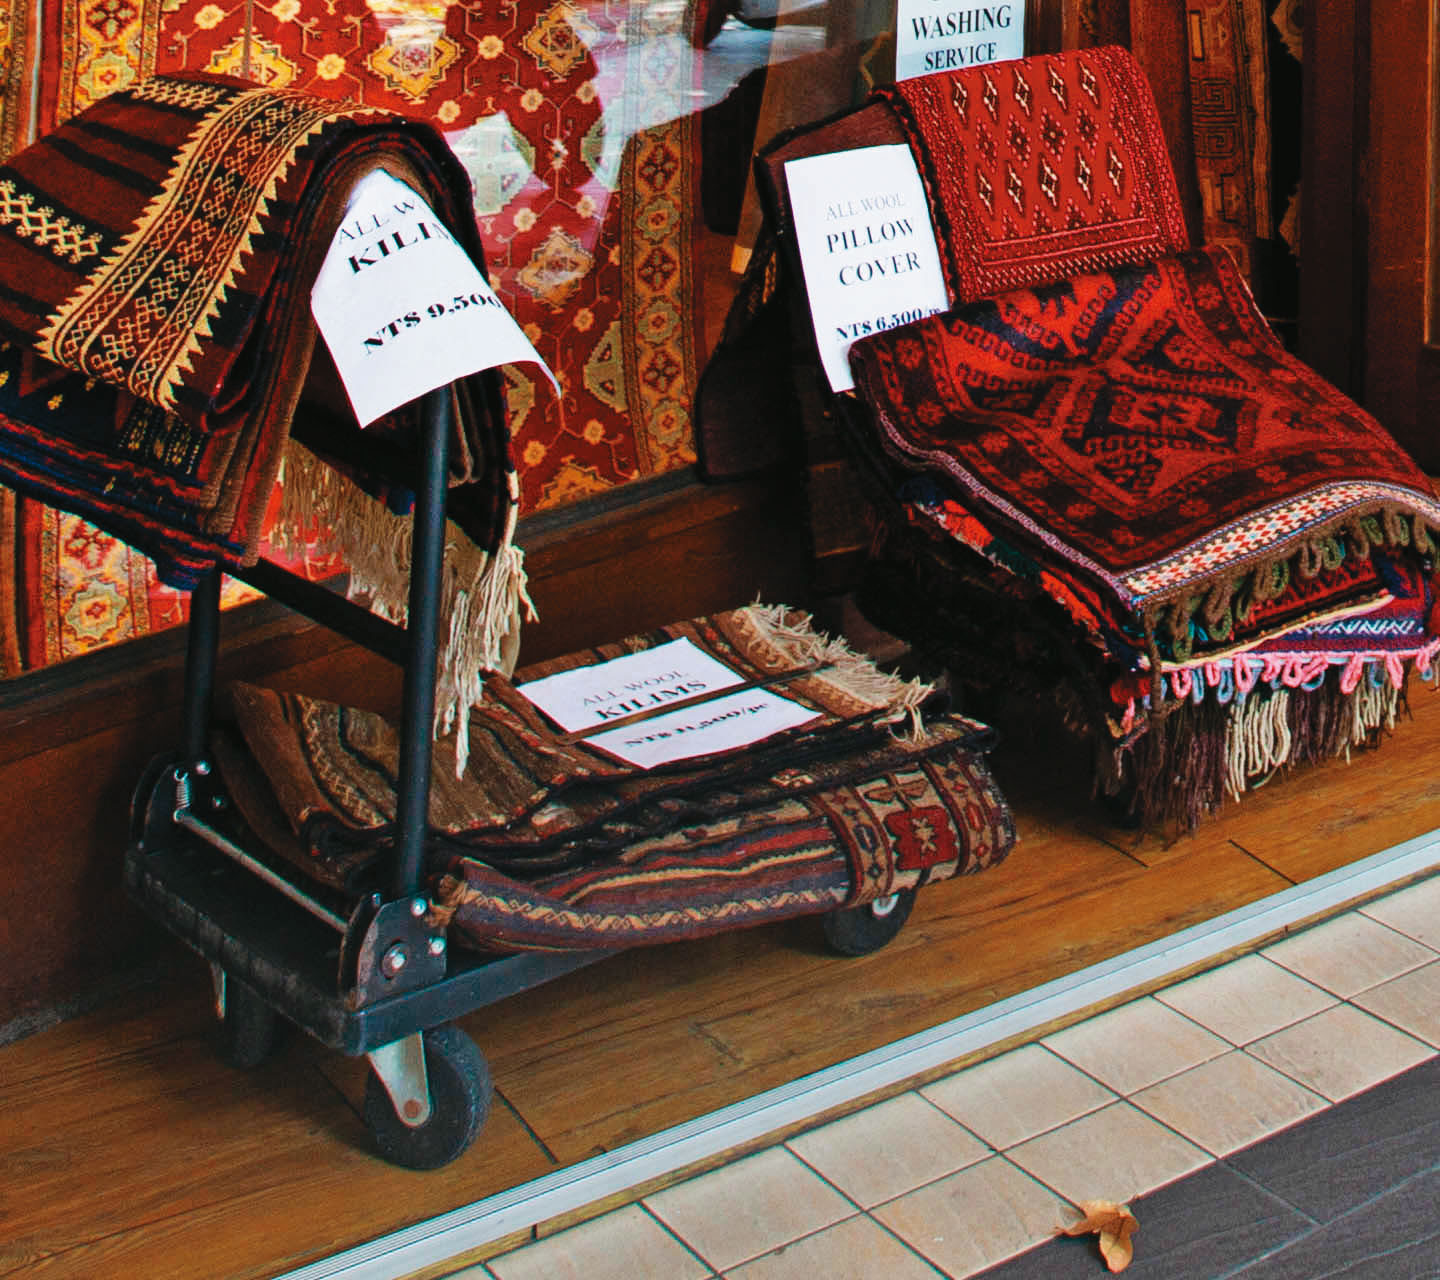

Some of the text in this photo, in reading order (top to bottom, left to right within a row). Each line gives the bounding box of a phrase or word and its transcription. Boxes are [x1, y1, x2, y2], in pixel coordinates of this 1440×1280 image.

[912, 4, 1012, 41] WASHING
[924, 42, 998, 72] SERVICE
[826, 191, 906, 222] ALL WOOL
[826, 217, 914, 254] PILLOW
[839, 251, 922, 287] COVER
[595, 680, 708, 721] KILIMS
